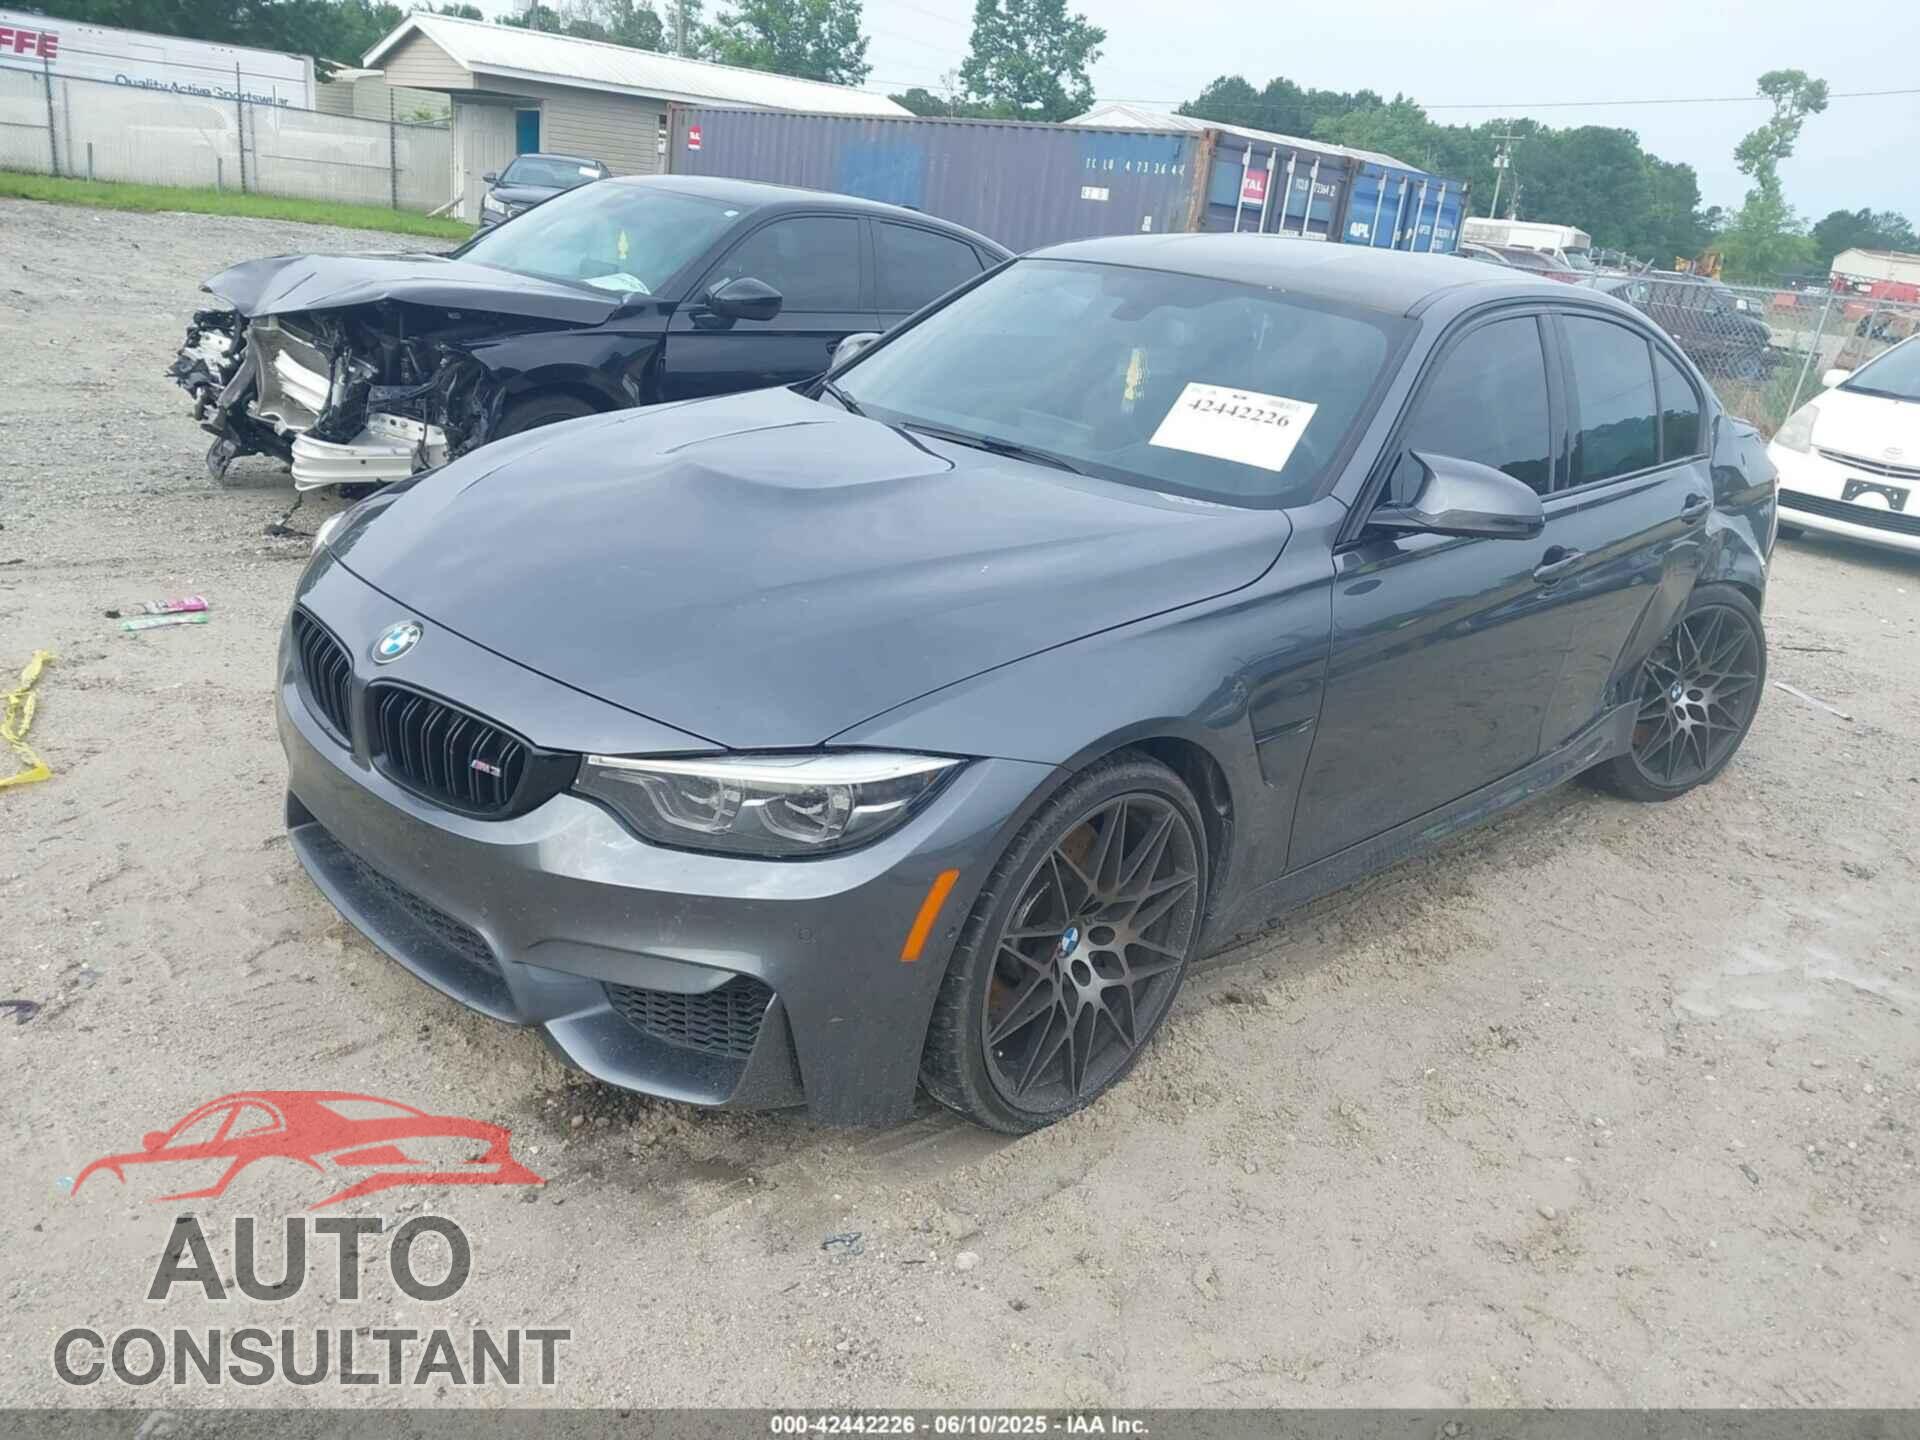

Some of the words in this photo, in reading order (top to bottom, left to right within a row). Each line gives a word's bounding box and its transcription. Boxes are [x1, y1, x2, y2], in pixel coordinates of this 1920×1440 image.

[115, 74, 168, 93] Quality
[171, 81, 212, 96] Active
[1187, 399, 1289, 427] 42442226
